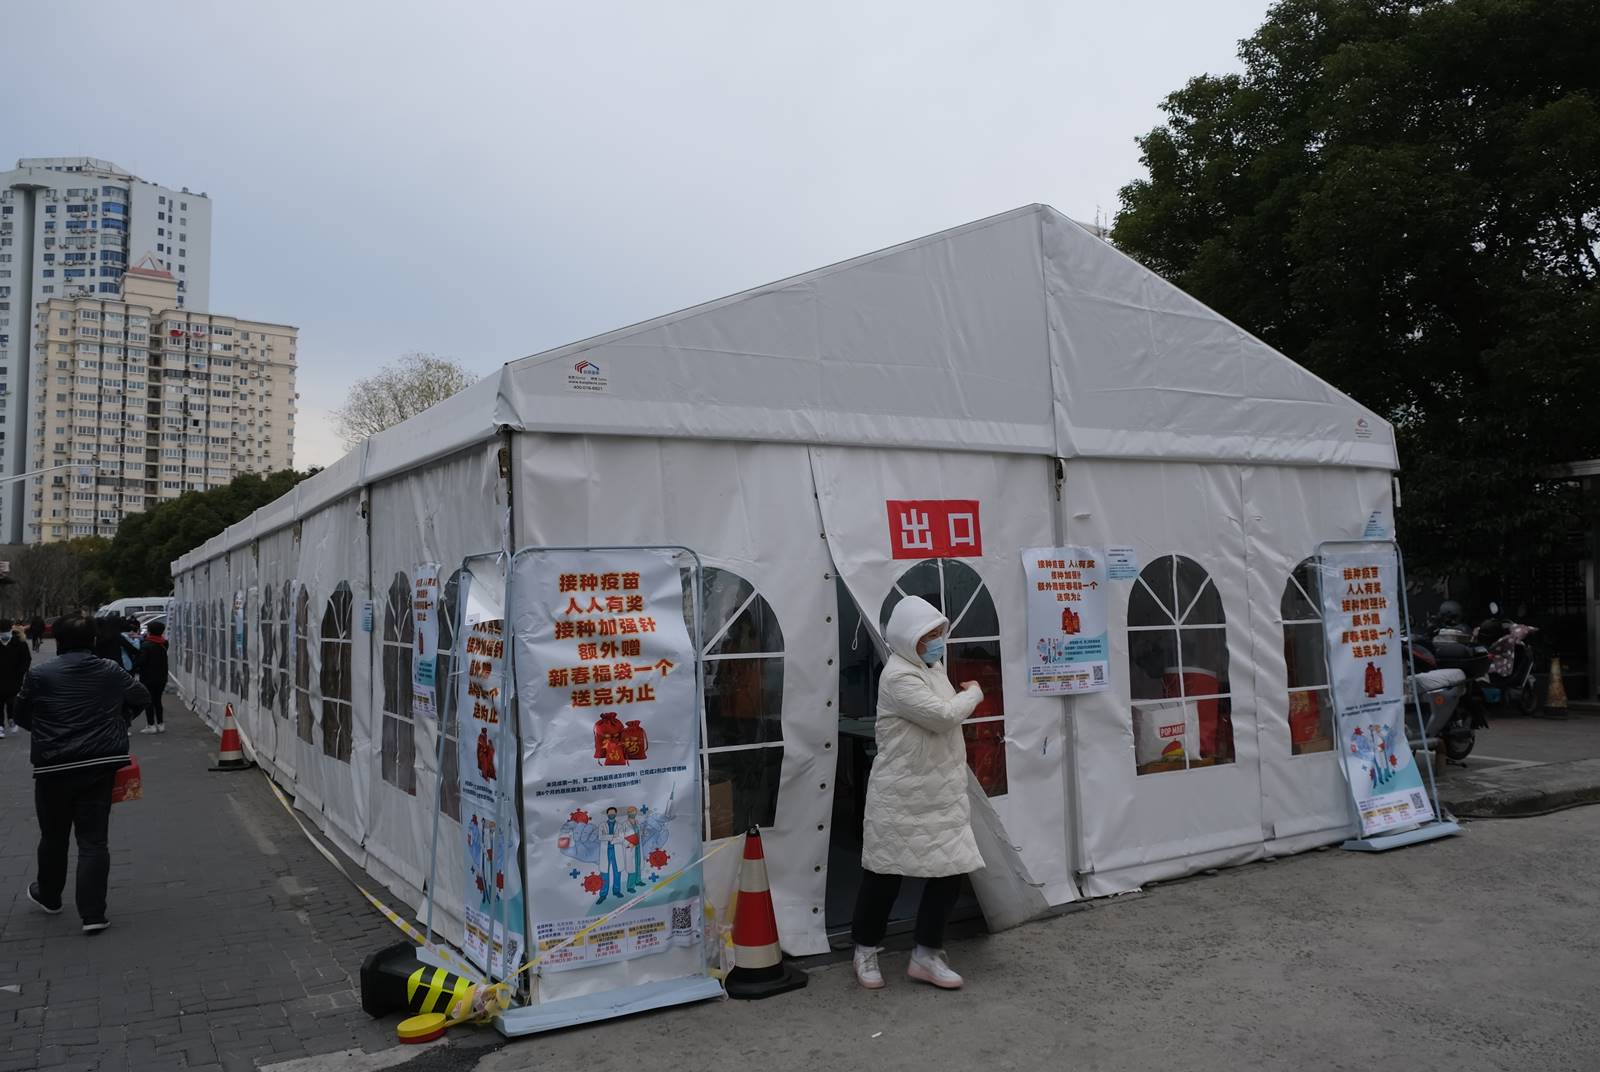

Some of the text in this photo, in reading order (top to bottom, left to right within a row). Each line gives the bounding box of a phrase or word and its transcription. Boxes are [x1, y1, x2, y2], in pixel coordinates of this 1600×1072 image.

[900, 508, 975, 550] 出口
[559, 572, 640, 593] 接种疫苗
[1347, 582, 1381, 595] 人人有奖
[565, 596, 643, 615] 人人有奖
[555, 618, 656, 640] 接种加强针
[578, 640, 641, 661] 额外赠
[548, 658, 674, 688] 新春福袋一个
[571, 683, 656, 708] 送完为止
[1160, 728, 1172, 737] POP
